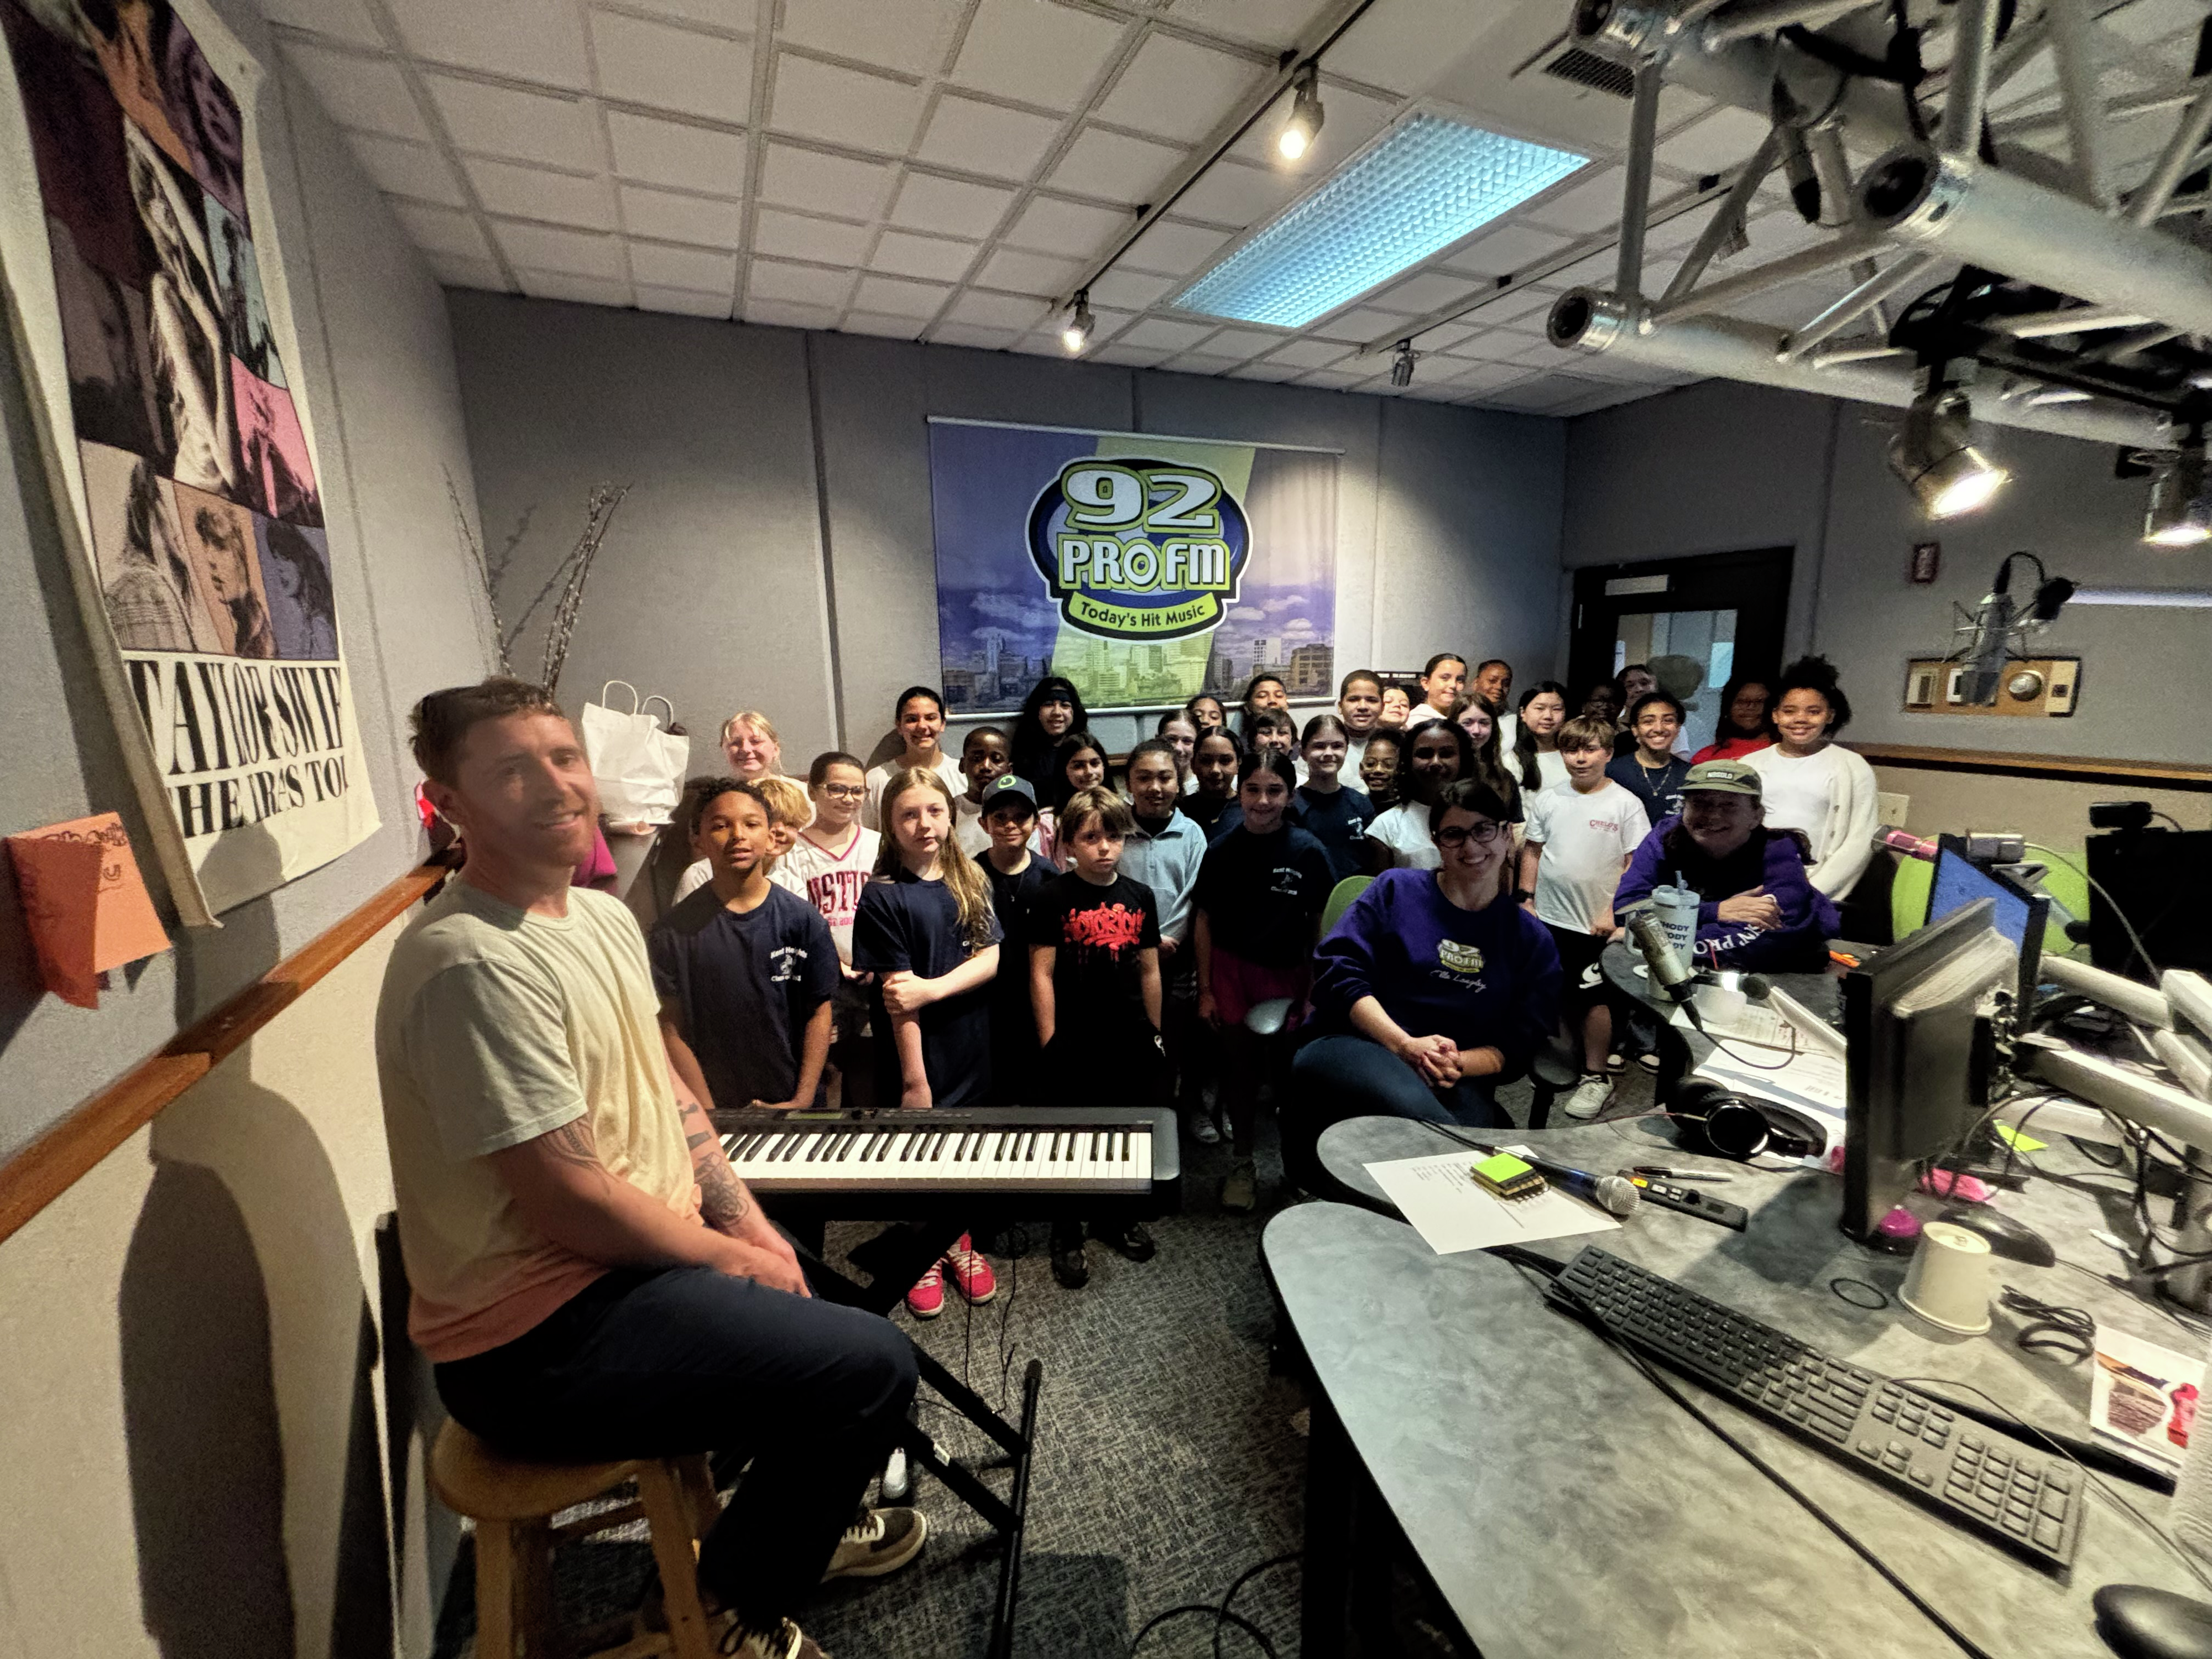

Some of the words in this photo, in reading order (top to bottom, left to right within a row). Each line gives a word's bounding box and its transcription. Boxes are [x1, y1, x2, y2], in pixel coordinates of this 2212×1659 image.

[1064, 466, 1218, 531] 92
[1081, 601, 1136, 628] Today's
[1141, 613, 1161, 627] Hit
[1165, 605, 1206, 625] Music
[123, 660, 281, 775] TAYLOR
[169, 779, 244, 839] HE
